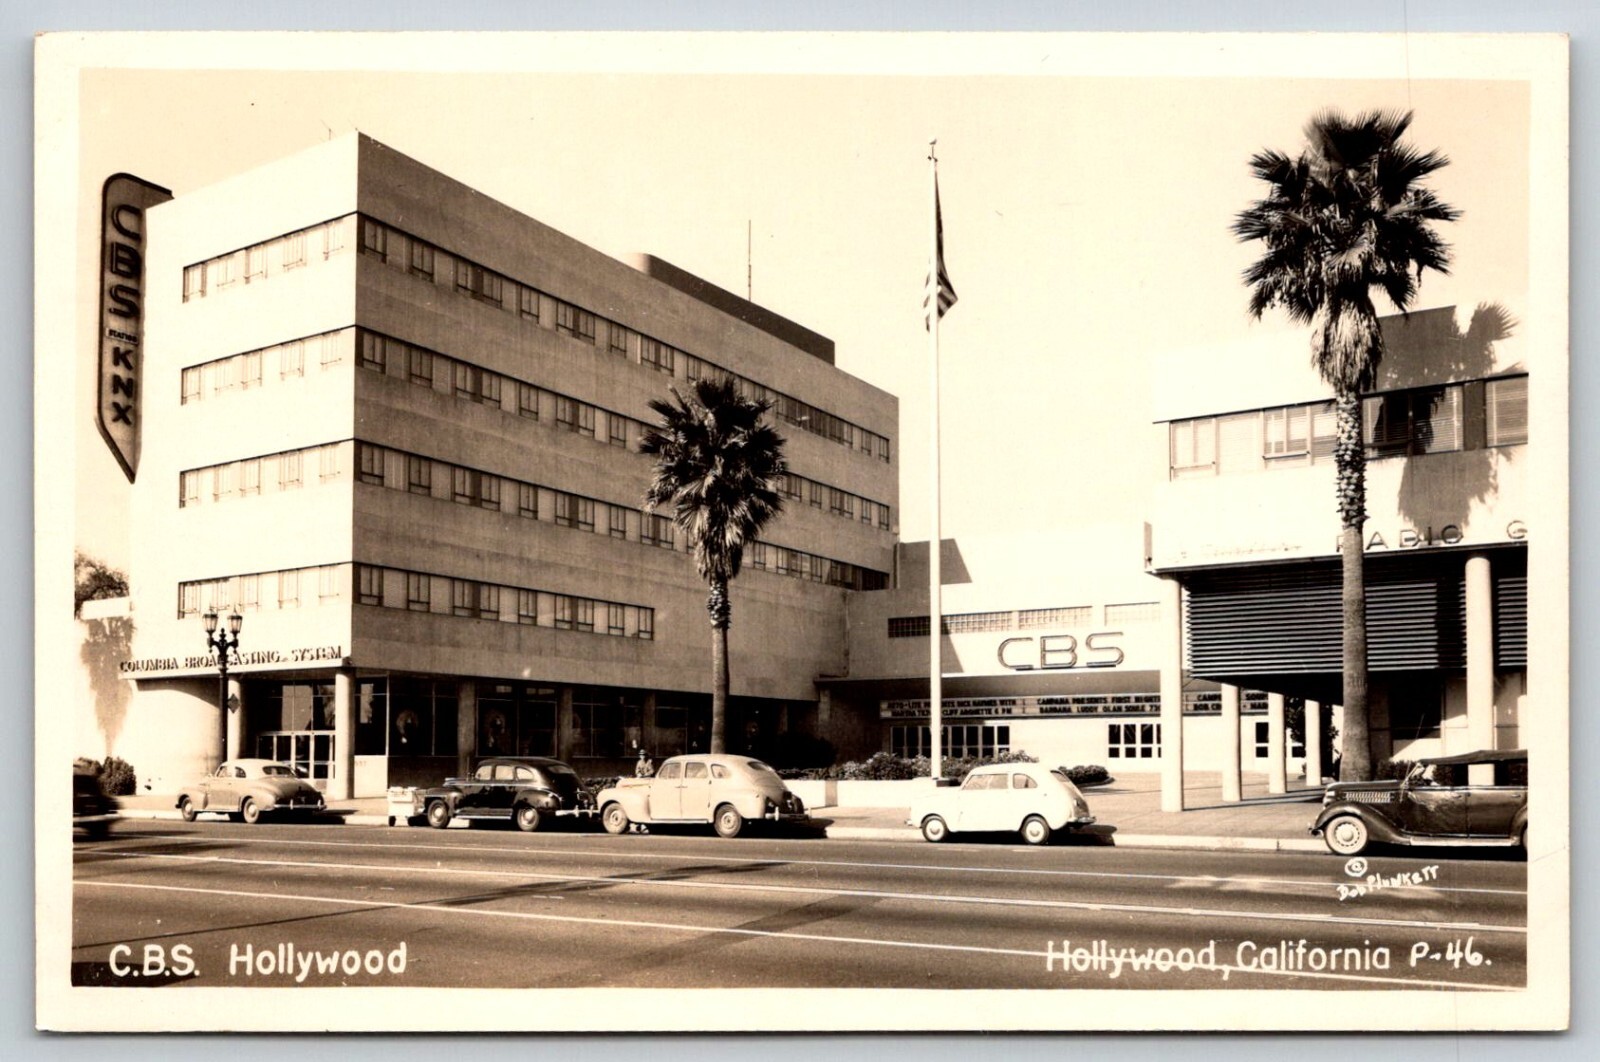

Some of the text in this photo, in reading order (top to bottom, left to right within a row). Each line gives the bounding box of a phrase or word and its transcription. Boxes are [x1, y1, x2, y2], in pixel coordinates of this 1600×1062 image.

[110, 204, 143, 318] CBS
[111, 346, 135, 426] KNX
[120, 656, 179, 672] COLUMBIA
[290, 645, 342, 662] SYSTEM
[997, 631, 1125, 671] CBS
[1072, 696, 1108, 704] PRESENTS
